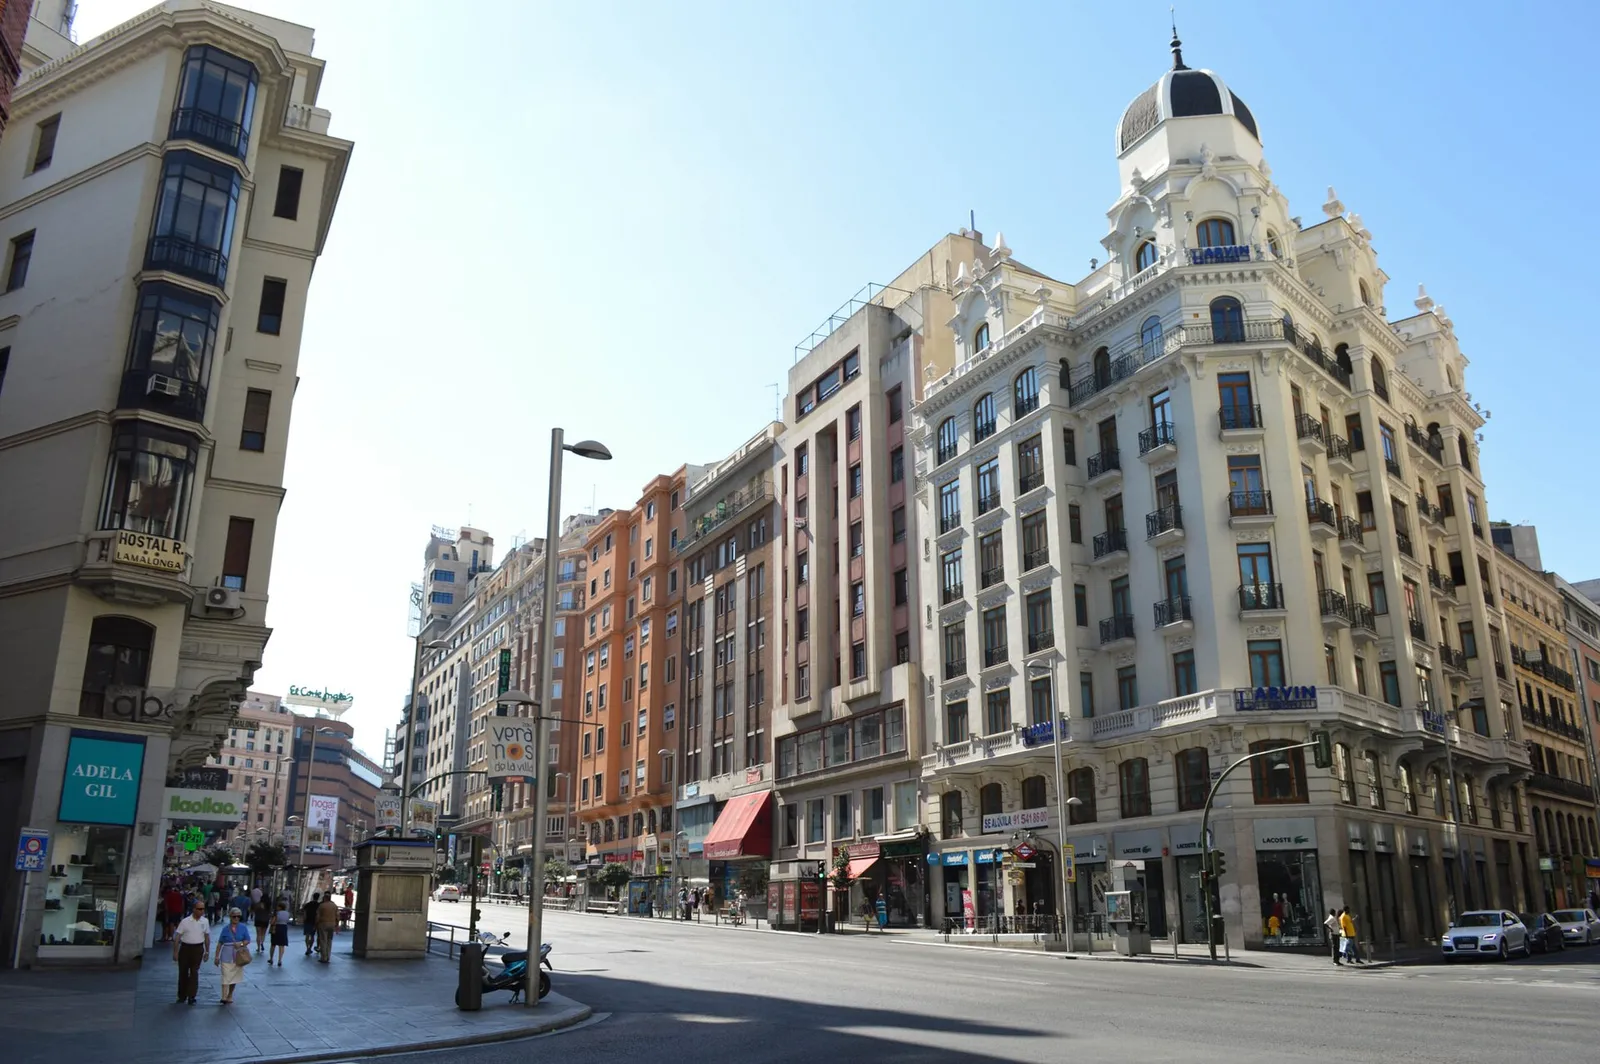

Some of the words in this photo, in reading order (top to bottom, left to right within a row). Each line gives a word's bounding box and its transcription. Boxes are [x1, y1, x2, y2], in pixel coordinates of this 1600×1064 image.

[119, 532, 168, 552] HOSTAL
[173, 542, 184, 555] R.
[117, 552, 181, 569] LAMALONGA
[500, 652, 510, 700] HOTE
[289, 684, 299, 696] El
[300, 686, 322, 699] Corte
[72, 763, 133, 781] ADELA
[494, 762, 506, 772] de
[507, 762, 515, 772] la
[85, 783, 117, 799] GIL
[311, 797, 337, 811] hogar
[984, 818, 991, 829] SE
[1013, 814, 1020, 825] 91
